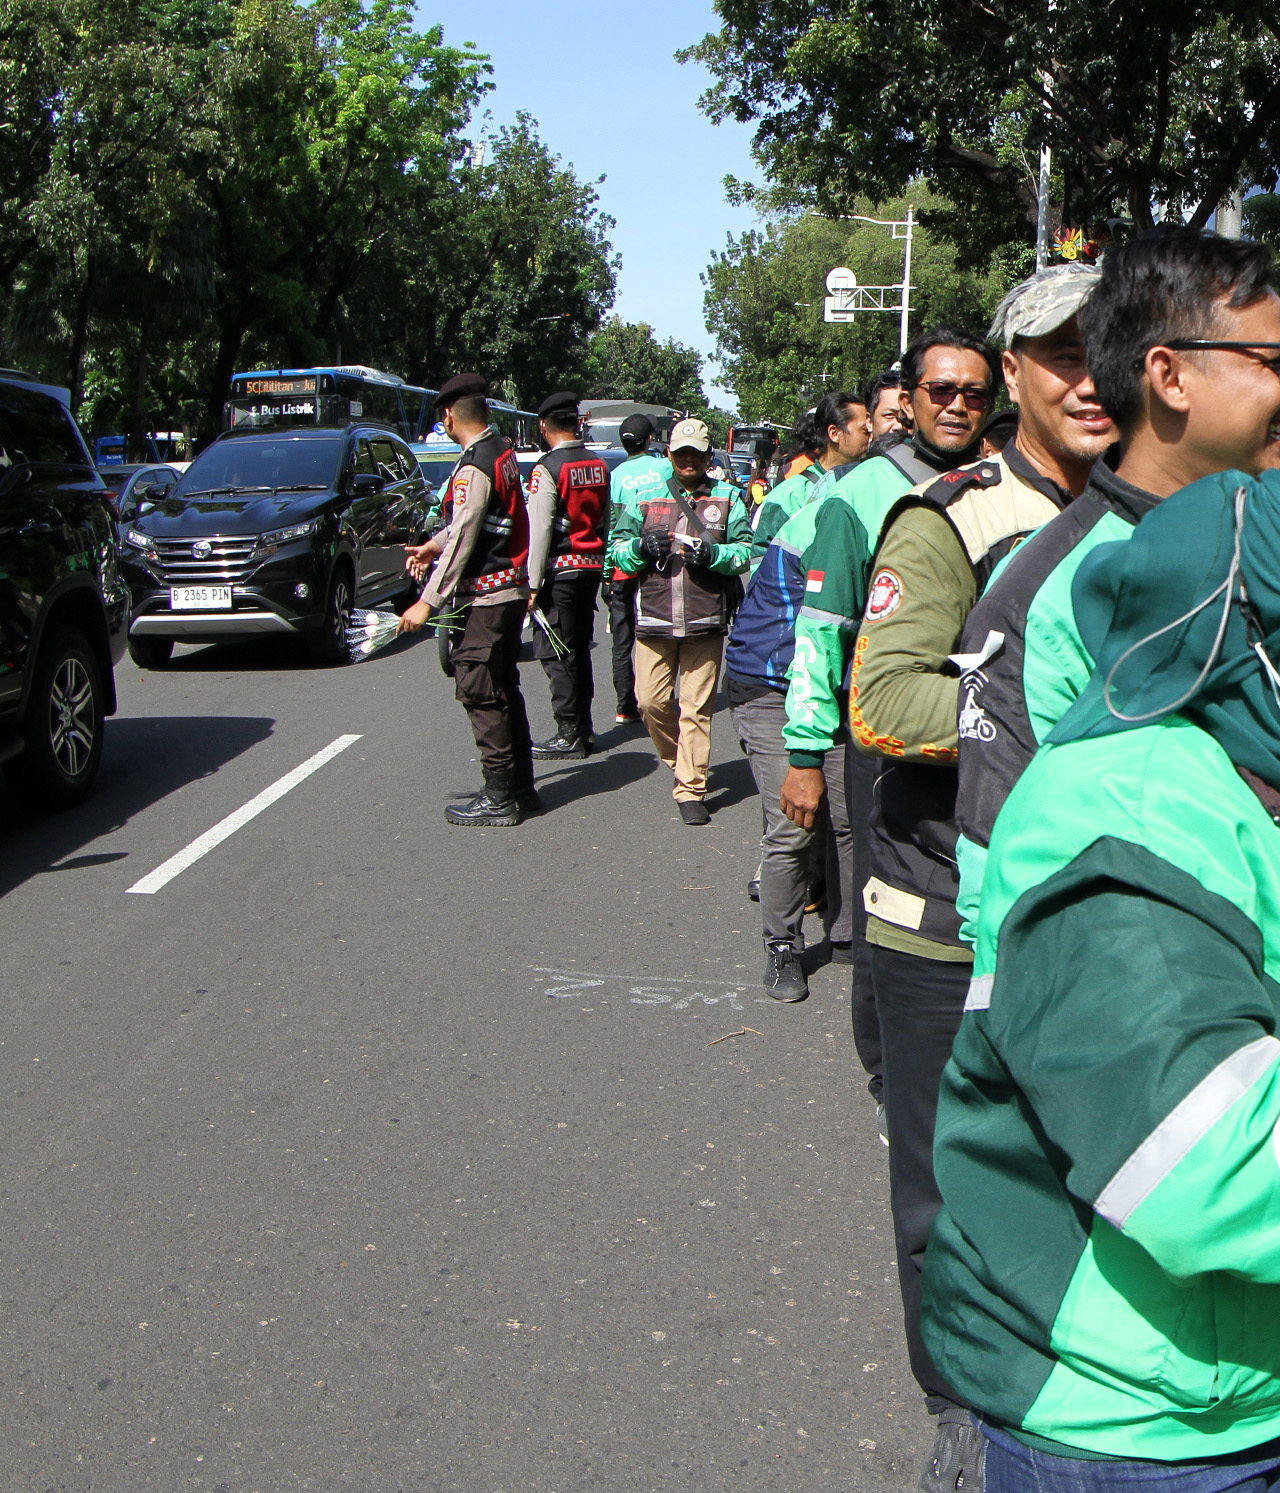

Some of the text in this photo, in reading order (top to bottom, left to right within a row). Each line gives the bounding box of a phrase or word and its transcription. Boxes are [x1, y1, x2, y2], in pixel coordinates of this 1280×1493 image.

[261, 402, 314, 415] Bus Listrik
[570, 466, 605, 486] POLISI
[621, 470, 662, 490] Grab
[173, 588, 230, 601] B 2365 PIN
